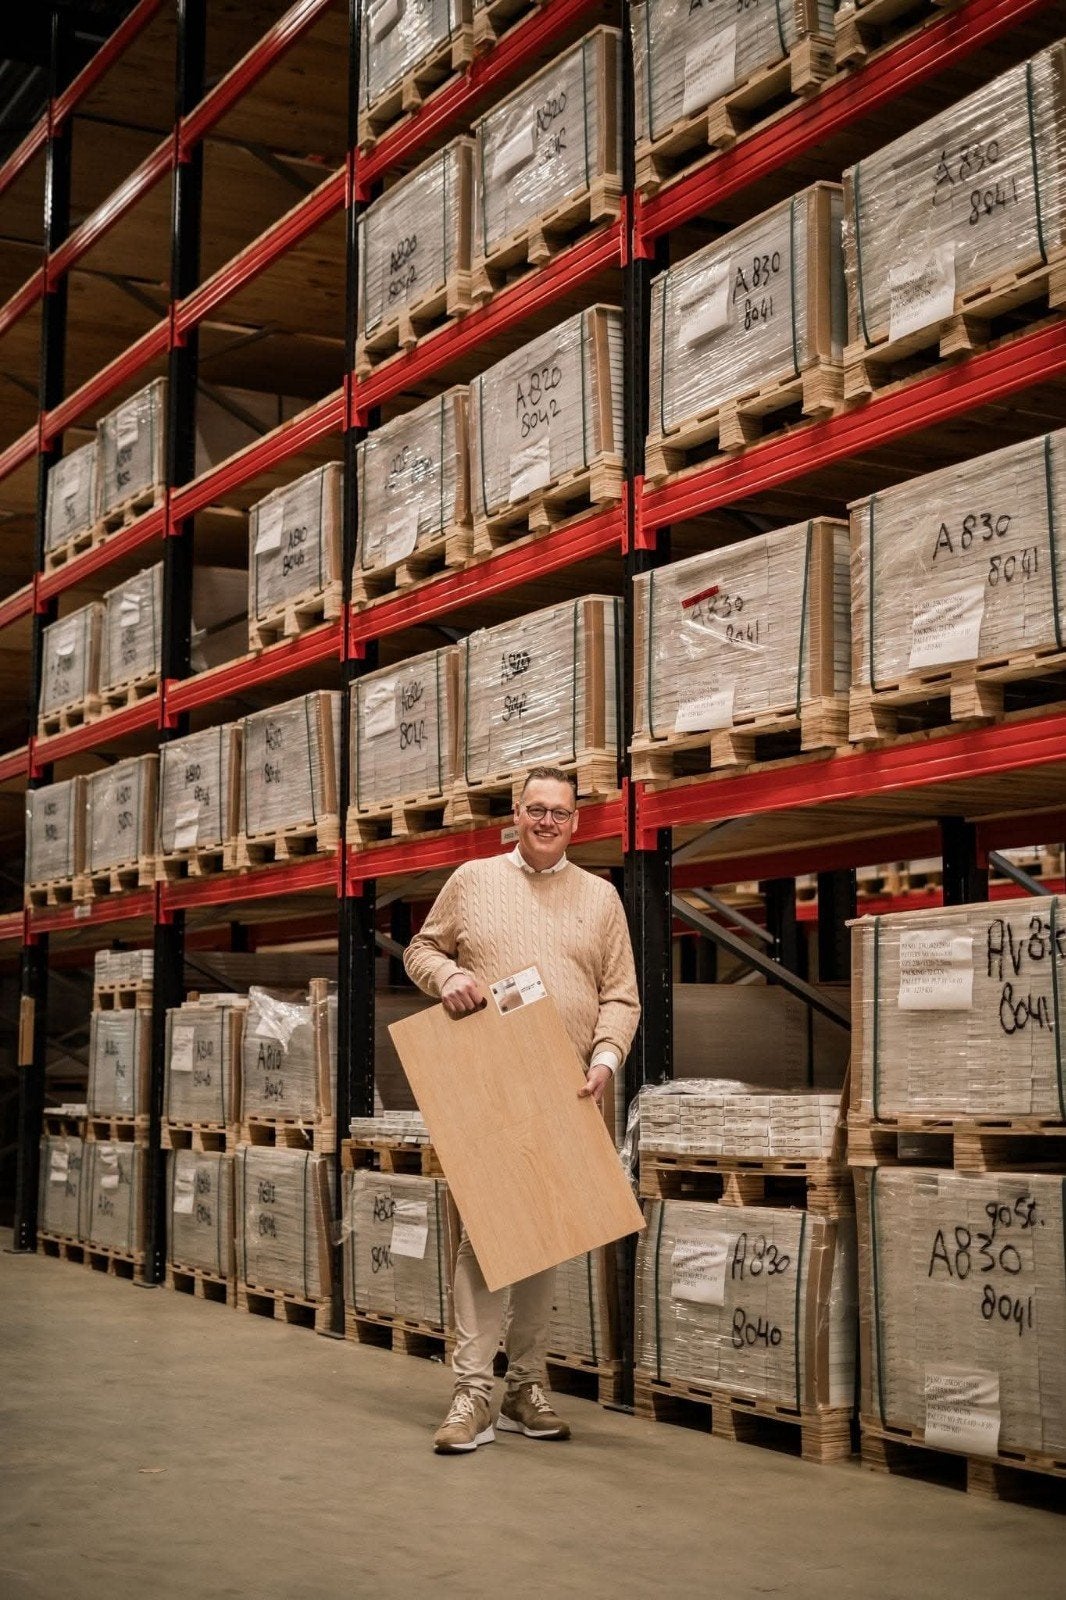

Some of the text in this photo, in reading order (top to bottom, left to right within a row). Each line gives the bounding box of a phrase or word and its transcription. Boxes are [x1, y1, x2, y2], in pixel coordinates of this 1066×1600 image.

[969, 177, 1018, 226] 8041
[744, 296, 773, 331] 8041
[516, 367, 562, 419] A820
[521, 399, 562, 438] 8042
[932, 512, 1011, 562] A830
[988, 545, 1038, 587] 8041
[999, 982, 1053, 1035] 8041
[732, 1233, 791, 1281] A830
[928, 1227, 1021, 1280] A830
[732, 1307, 782, 1349] 8040
[982, 1284, 1032, 1337] 8041
